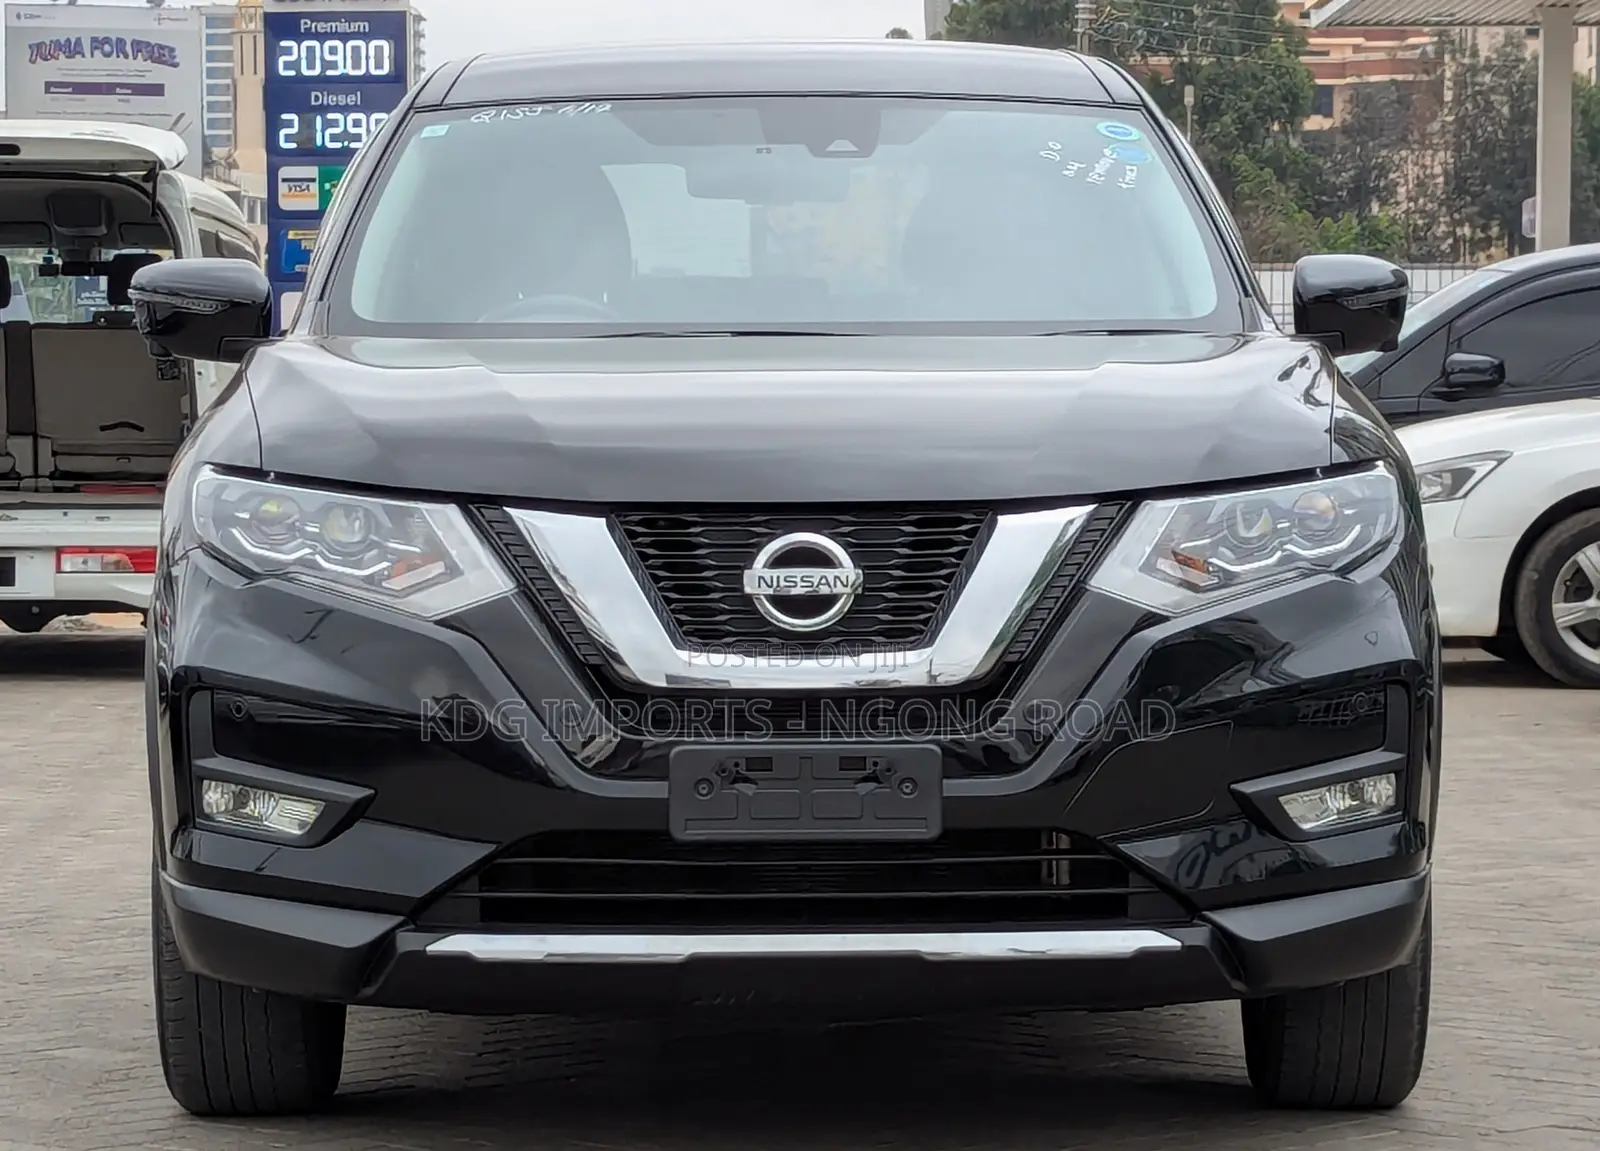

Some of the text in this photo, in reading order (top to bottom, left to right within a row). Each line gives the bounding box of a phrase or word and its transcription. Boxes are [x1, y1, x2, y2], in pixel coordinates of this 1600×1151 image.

[300, 18, 369, 33] Premium
[90, 36, 129, 60] FOR
[130, 38, 180, 69] FREE
[311, 91, 361, 106] Diesel
[287, 183, 311, 193] VISA
[757, 574, 849, 588] NISSAN
